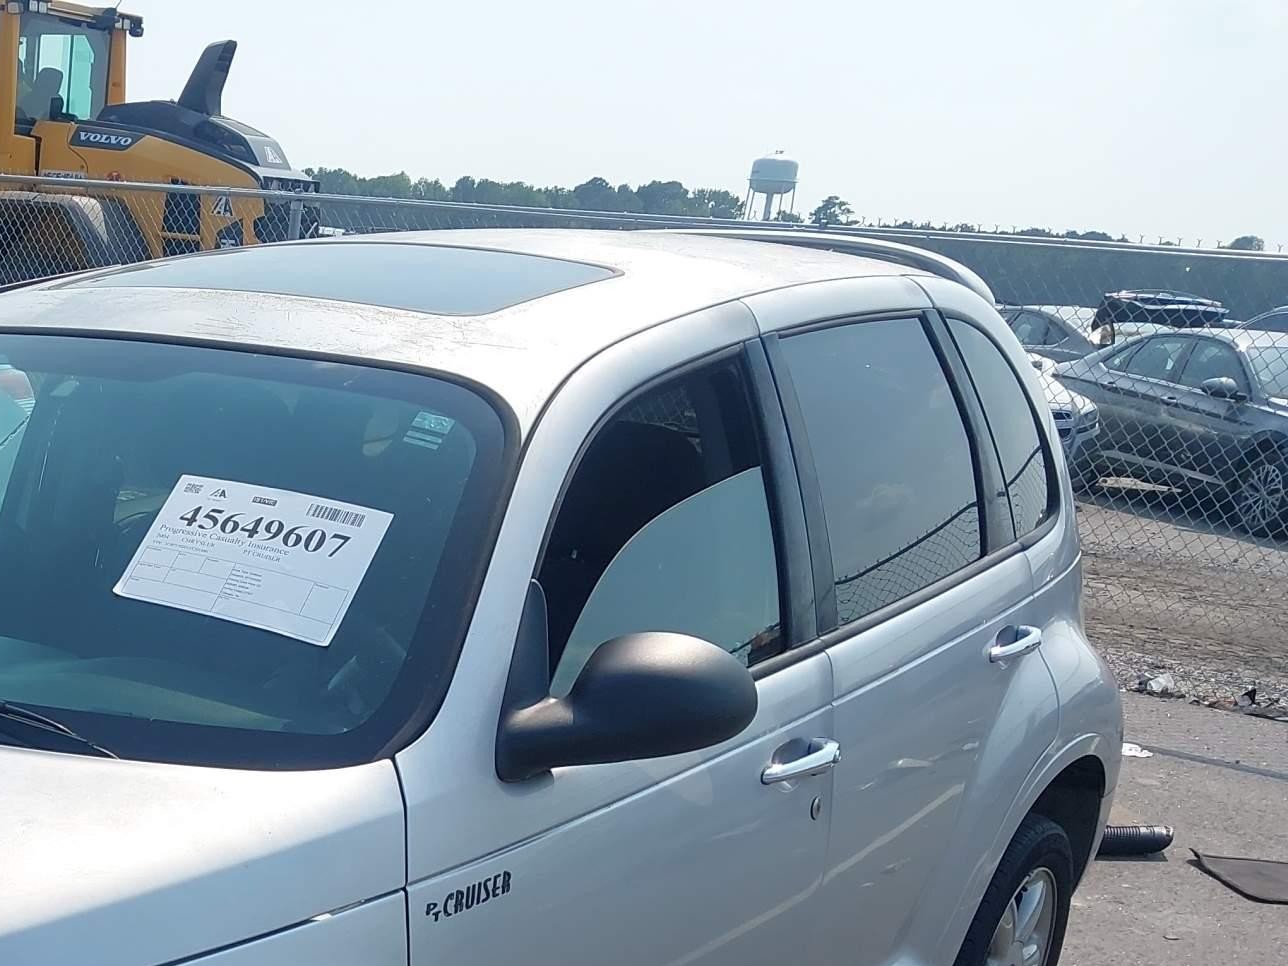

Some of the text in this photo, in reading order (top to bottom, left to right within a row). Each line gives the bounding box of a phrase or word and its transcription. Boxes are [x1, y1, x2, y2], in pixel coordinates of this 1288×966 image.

[79, 131, 133, 146] VOLVO
[159, 523, 208, 540] Progressive
[209, 532, 246, 547] Casualty
[247, 540, 291, 557] Insurance
[179, 505, 352, 558] 45649607
[181, 537, 216, 548] CHRYSLER
[251, 550, 282, 563] CRUISER
[443, 870, 512, 918] CRUISER
